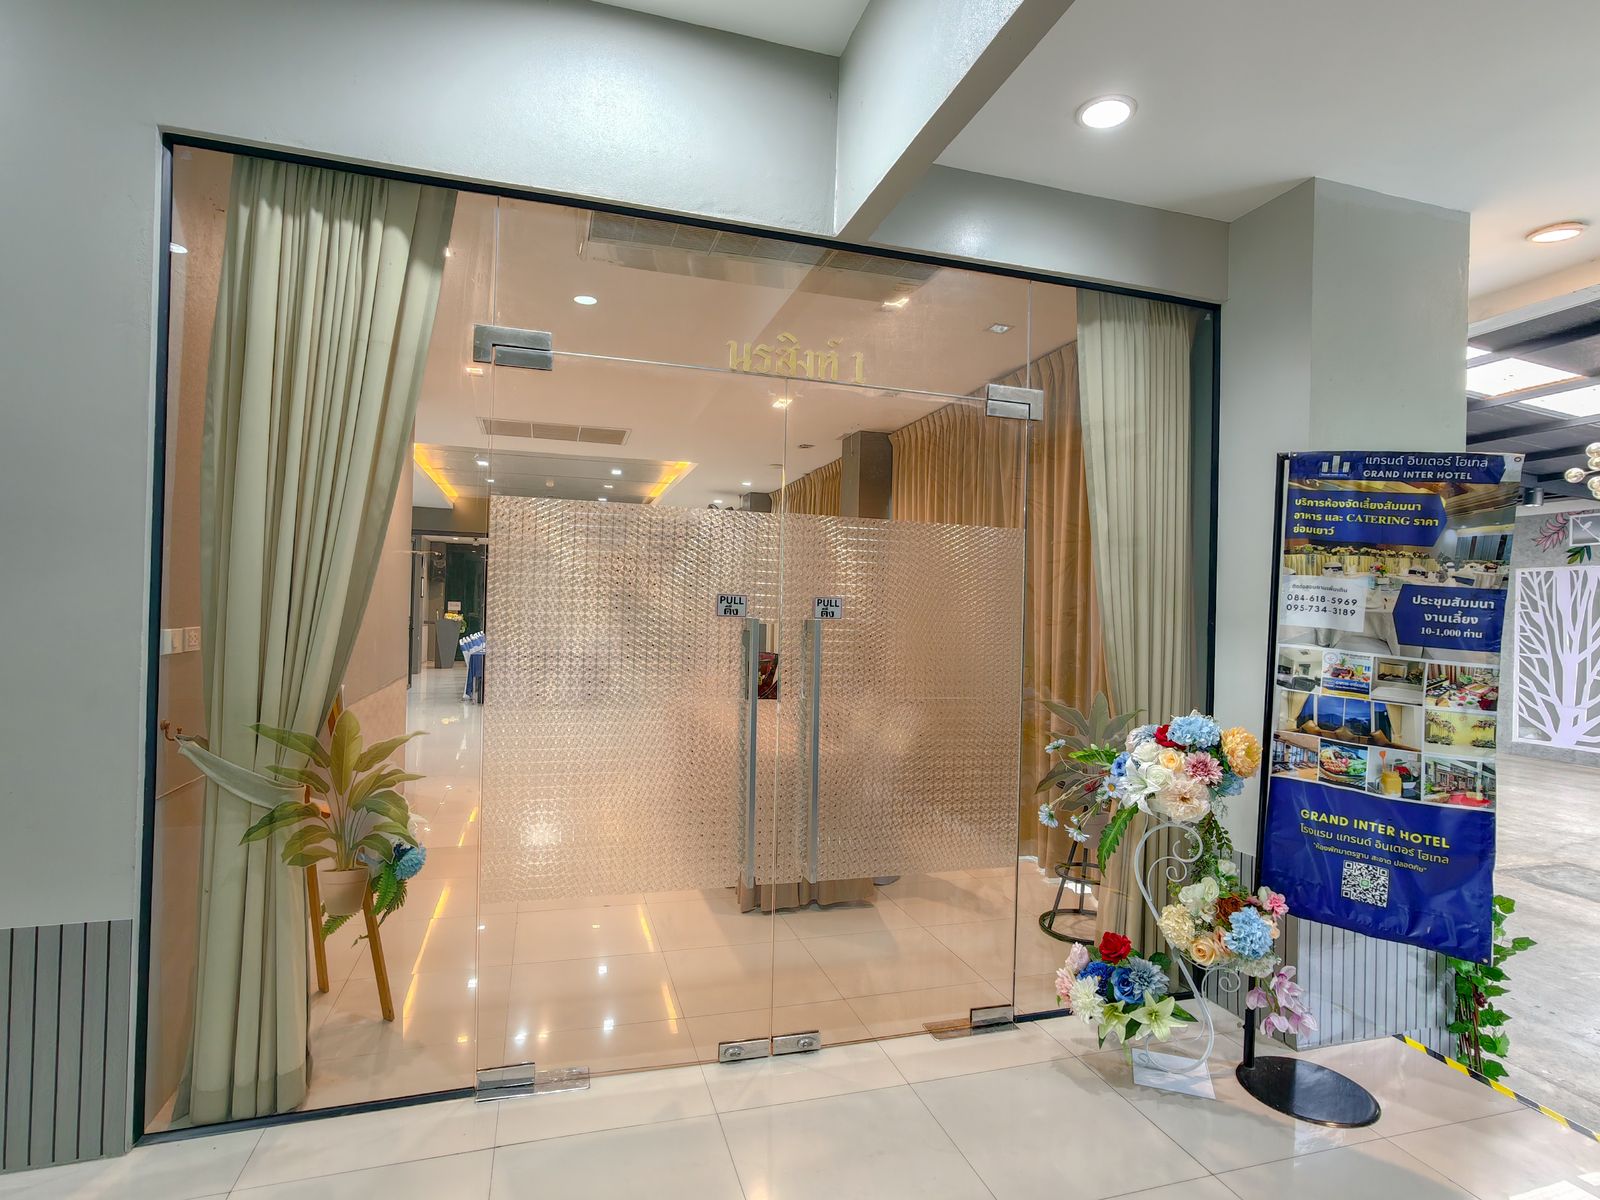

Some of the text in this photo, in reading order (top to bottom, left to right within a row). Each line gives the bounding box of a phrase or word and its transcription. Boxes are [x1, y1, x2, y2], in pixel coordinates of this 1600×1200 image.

[851, 351, 866, 384] 1
[1365, 455, 1404, 466] แกรนด์
[1455, 455, 1489, 468] โฮเทล
[1363, 469, 1473, 480] GRAND INTER HOTEL
[1293, 512, 1440, 527] อาหาร และ CATERING ราคา
[1293, 523, 1336, 536] ย่อมเยาว์
[719, 595, 744, 605] PULL
[816, 598, 840, 607] PULL
[1286, 593, 1358, 606] 084-618-5969
[1412, 595, 1495, 609] ประชุมสัมมนา
[723, 605, 739, 615] ดึง
[820, 607, 835, 618] ดึง
[1286, 603, 1357, 617] 095-734-3189
[1424, 610, 1479, 625] งานเลี้ยง
[1420, 626, 1483, 639] 10-1,000 ท่าน
[1300, 808, 1450, 849] GRAND INTER HOTEL
[1300, 822, 1449, 864] โรงแรม แกรนด์ อินเตอร์ โฮเทล
